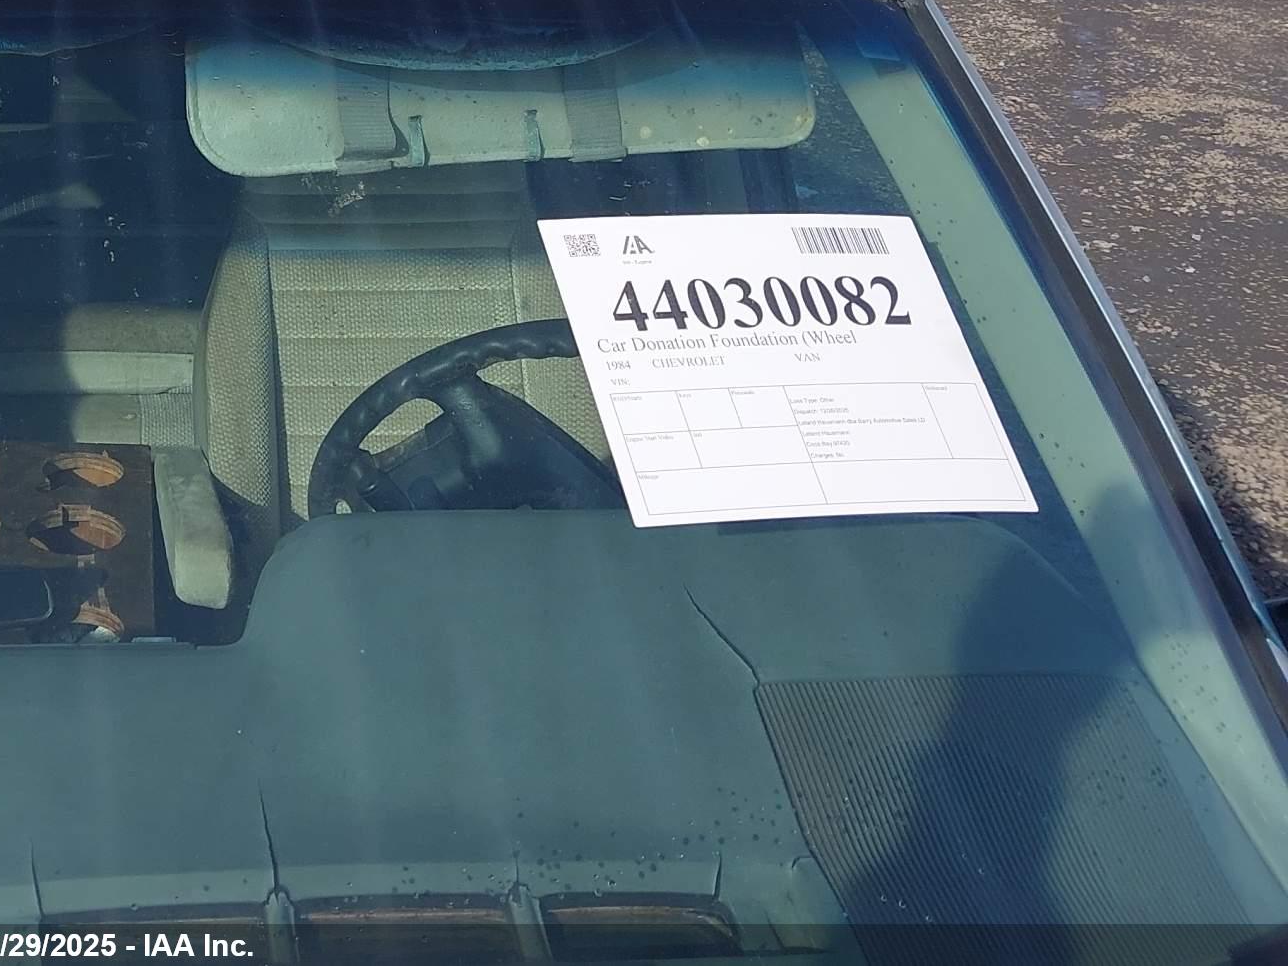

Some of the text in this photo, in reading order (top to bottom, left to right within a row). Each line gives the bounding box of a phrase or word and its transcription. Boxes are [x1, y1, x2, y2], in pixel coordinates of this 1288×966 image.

[612, 275, 912, 332] 44030082
[597, 329, 857, 354] Car Donation Foundation (Wheel
[605, 352, 822, 371] 1984 CHEVROLET VAN
[610, 377, 631, 387] VIN:
